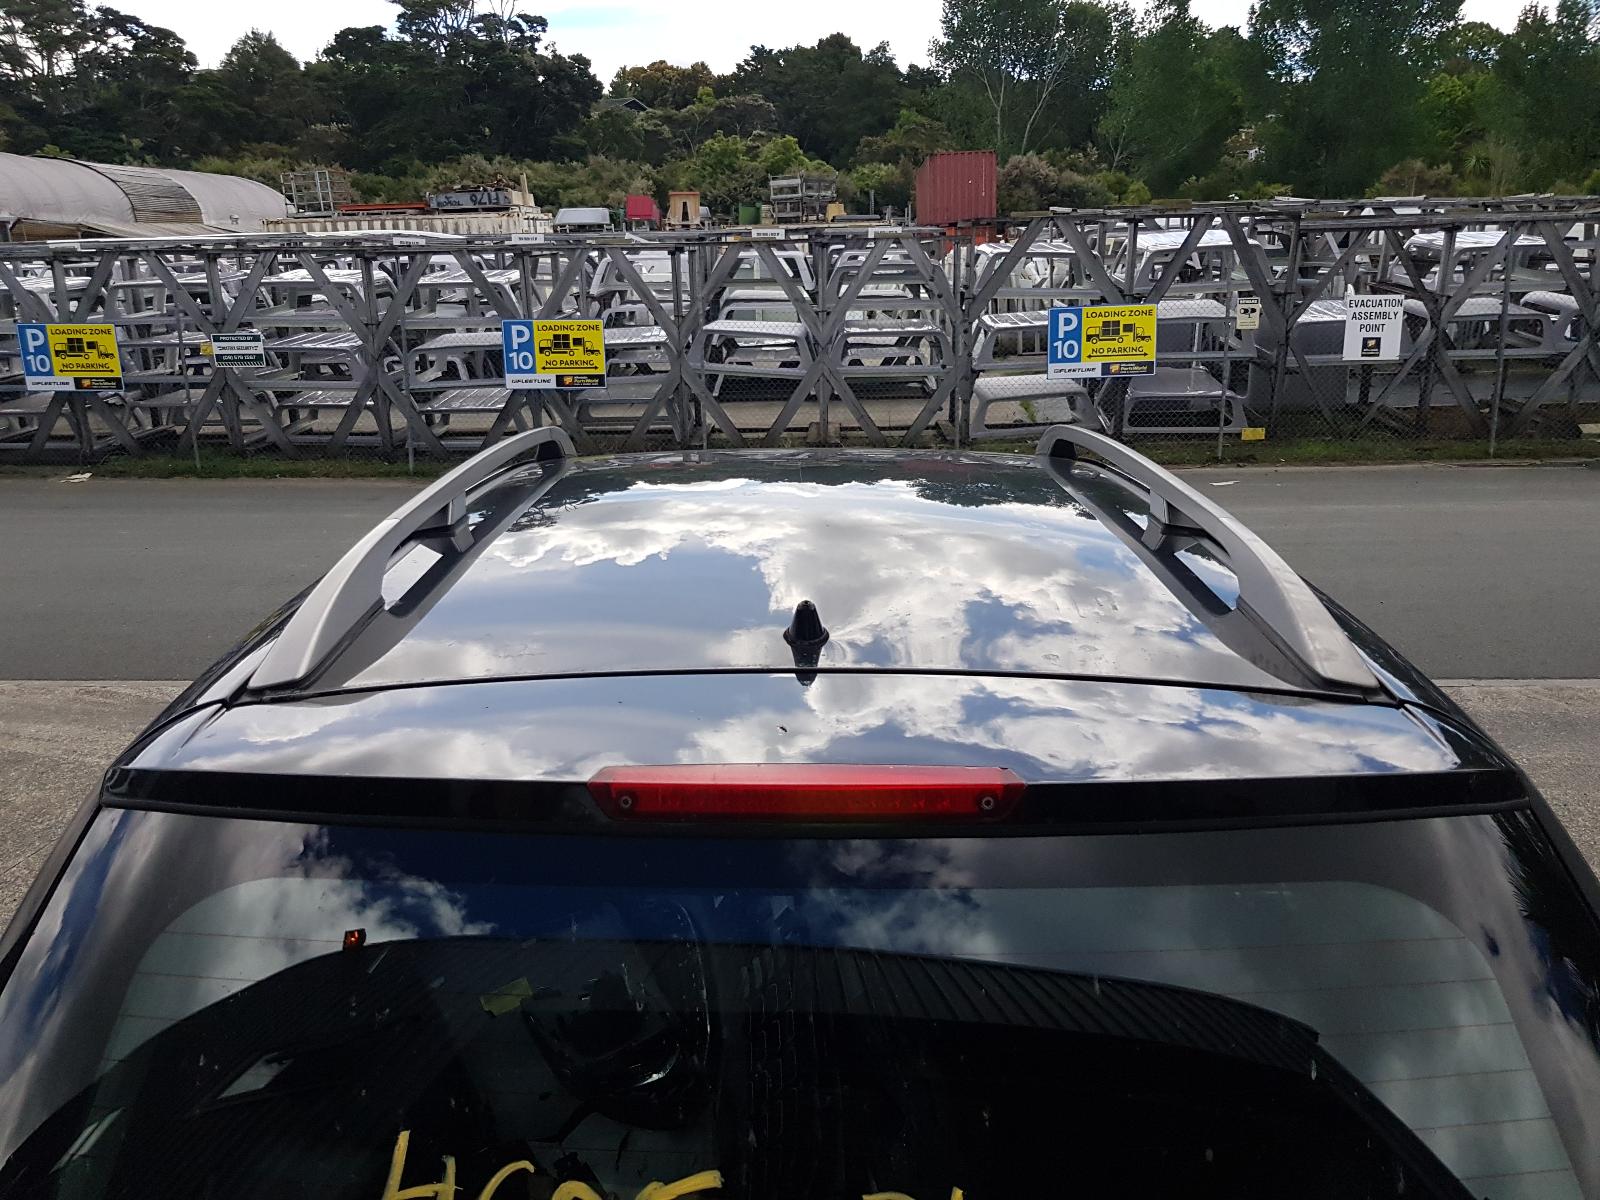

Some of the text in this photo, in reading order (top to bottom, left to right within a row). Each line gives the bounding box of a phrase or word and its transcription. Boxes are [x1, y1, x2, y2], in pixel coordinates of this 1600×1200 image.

[1349, 299, 1403, 308] EVACUATION
[1086, 310, 1126, 318] LOADING
[1351, 311, 1398, 320] ASSEMBLY
[1058, 312, 1078, 338] P
[1359, 323, 1386, 332] POINT
[25, 328, 45, 352] P
[511, 325, 531, 349] P
[1053, 340, 1079, 359] 10
[1107, 346, 1144, 354] PARKING
[26, 354, 50, 372] 10
[508, 351, 534, 370] 10
